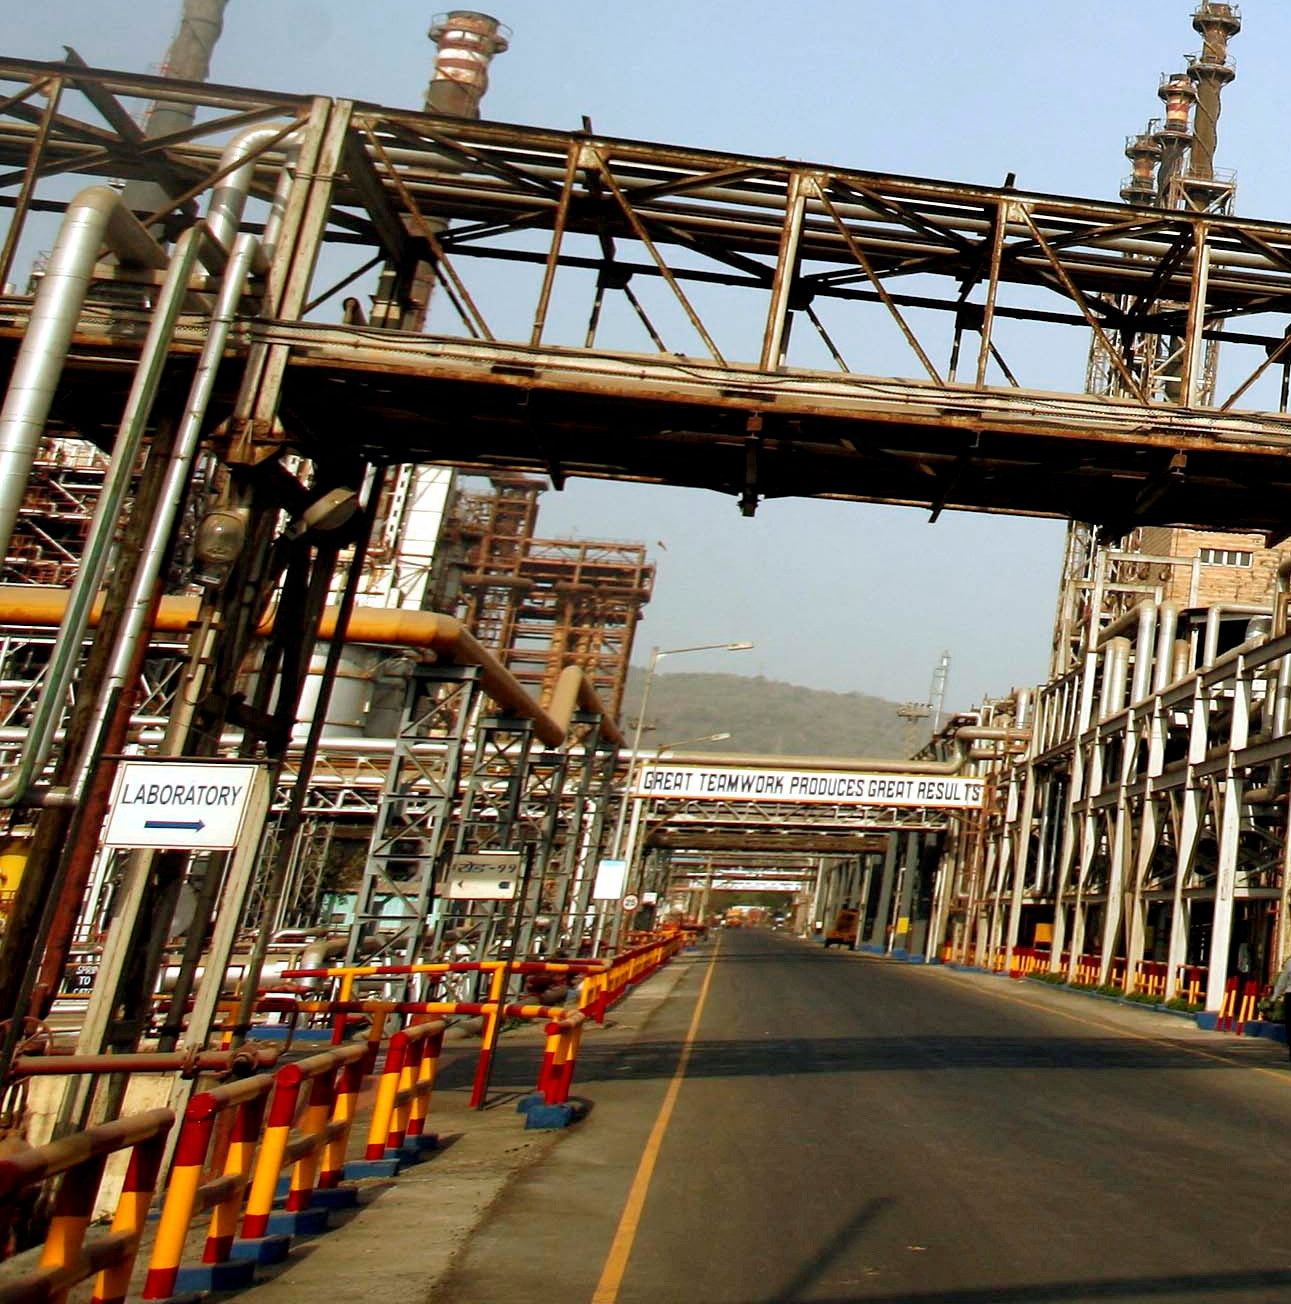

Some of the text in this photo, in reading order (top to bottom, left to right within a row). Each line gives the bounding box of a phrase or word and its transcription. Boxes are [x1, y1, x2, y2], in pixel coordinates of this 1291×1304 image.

[121, 784, 243, 806] LABORATORY
[643, 771, 981, 802] GREAT TEAMWORK PRODUCES GREAT RESULTS
